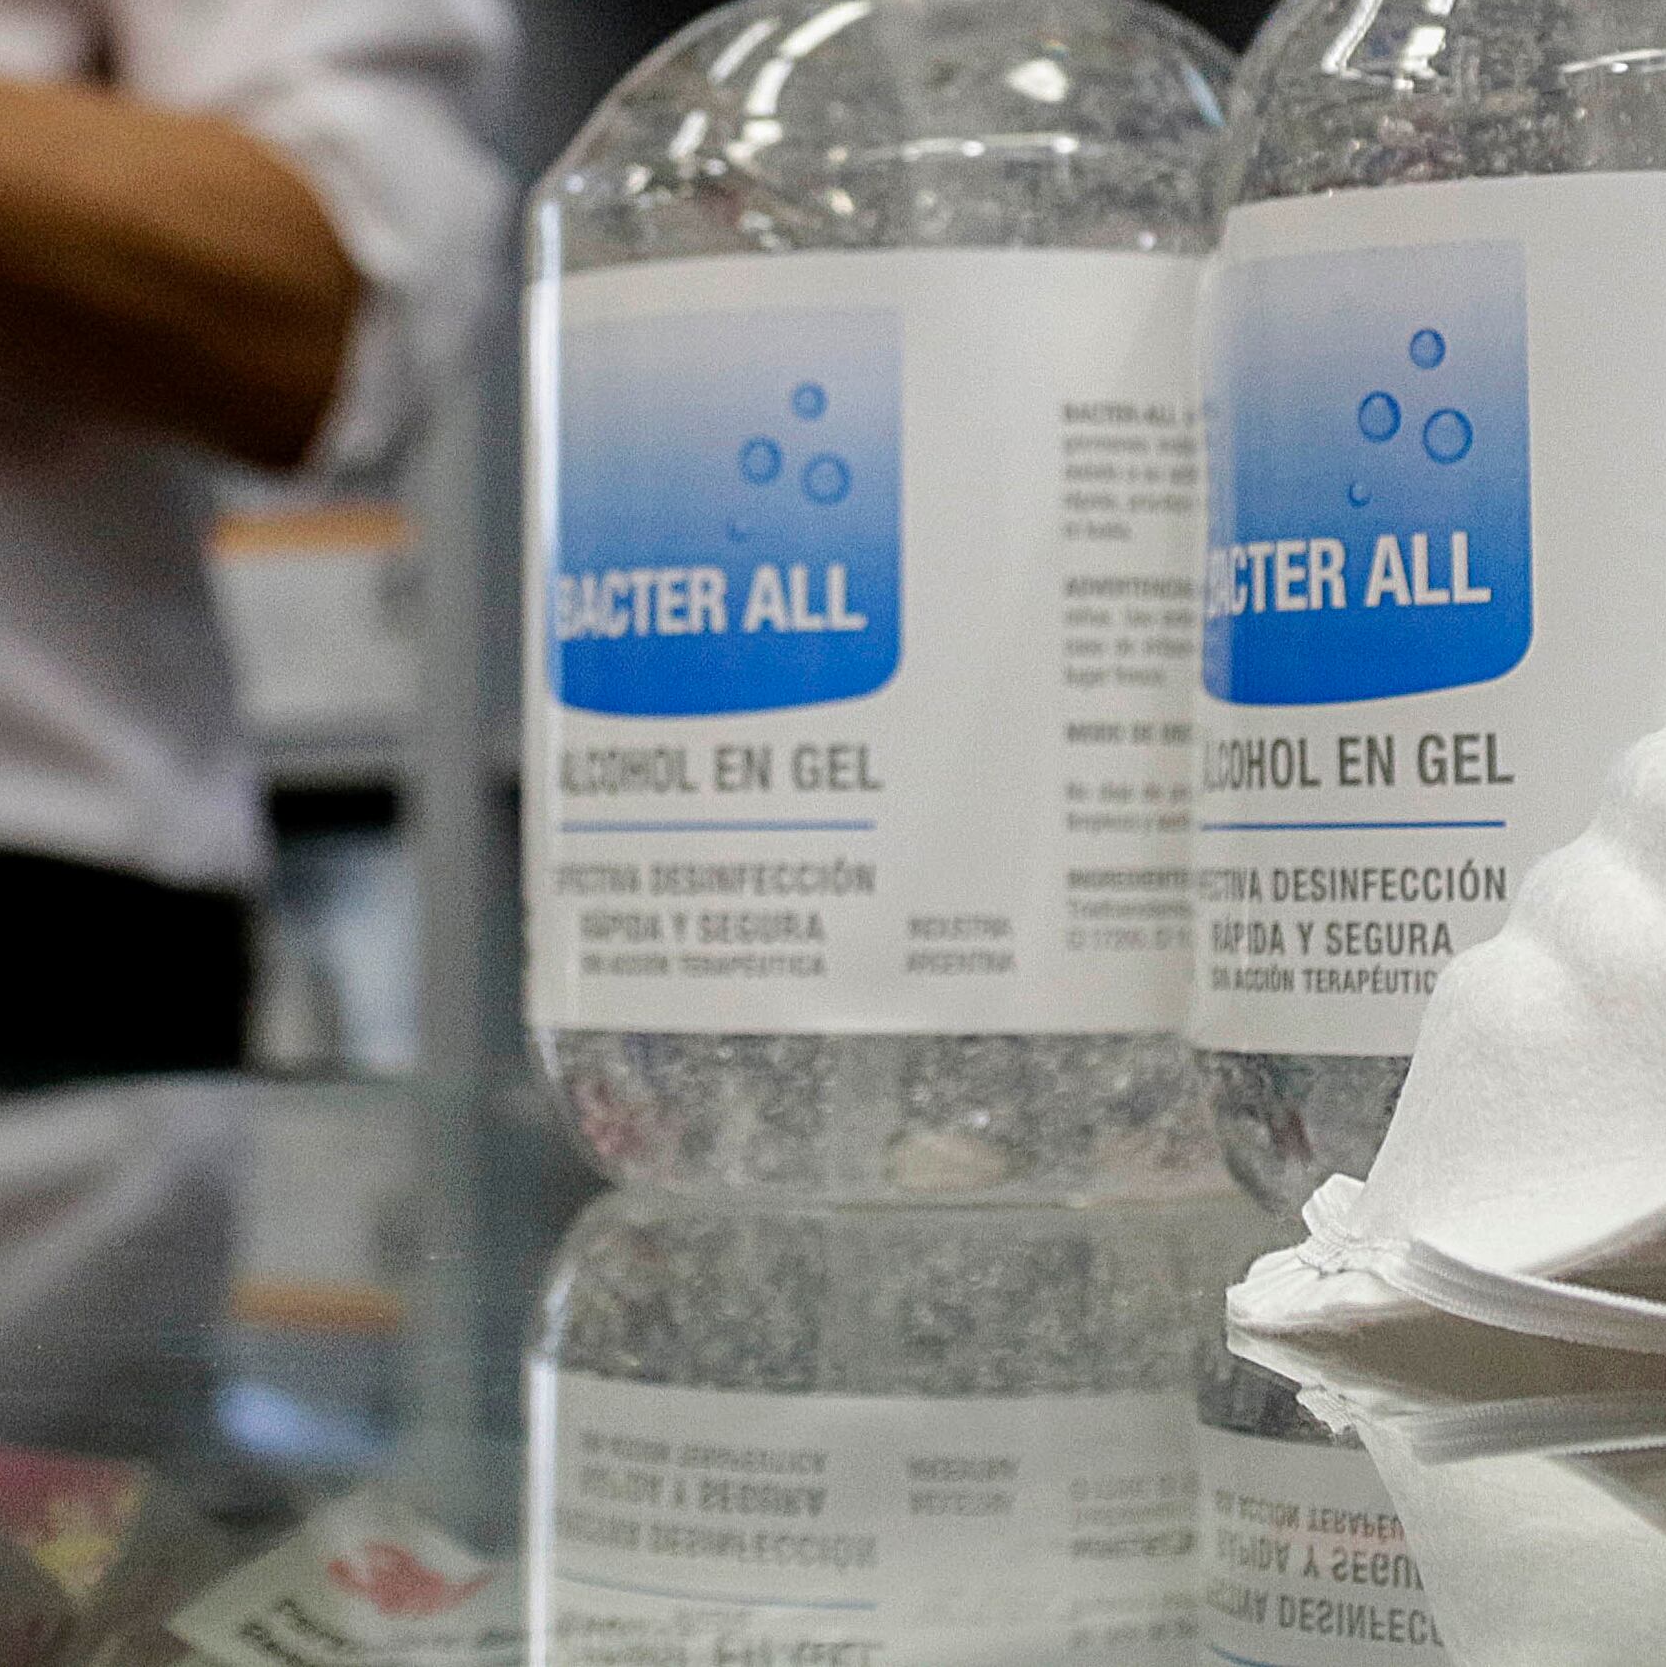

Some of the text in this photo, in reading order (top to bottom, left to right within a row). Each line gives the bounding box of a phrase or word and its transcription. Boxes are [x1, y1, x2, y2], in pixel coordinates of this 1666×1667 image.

[1363, 531, 1493, 608] ALL
[741, 564, 870, 632] ALL
[713, 743, 774, 793] EN
[790, 740, 884, 793] GEL
[1337, 734, 1397, 787] EN
[1416, 732, 1516, 786] GEL
[649, 855, 878, 897] DESINFECCIÓN
[1272, 858, 1508, 903] DESINFECCIÓN
[670, 910, 687, 943] Y
[696, 909, 826, 944] SEGURA
[1210, 917, 1285, 956] RÁPIDA
[1296, 920, 1314, 956] Y
[1325, 920, 1454, 956] SEGURA
[1235, 963, 1295, 993] ACCIÓN
[1302, 964, 1437, 995] TERAPÉUTIC
